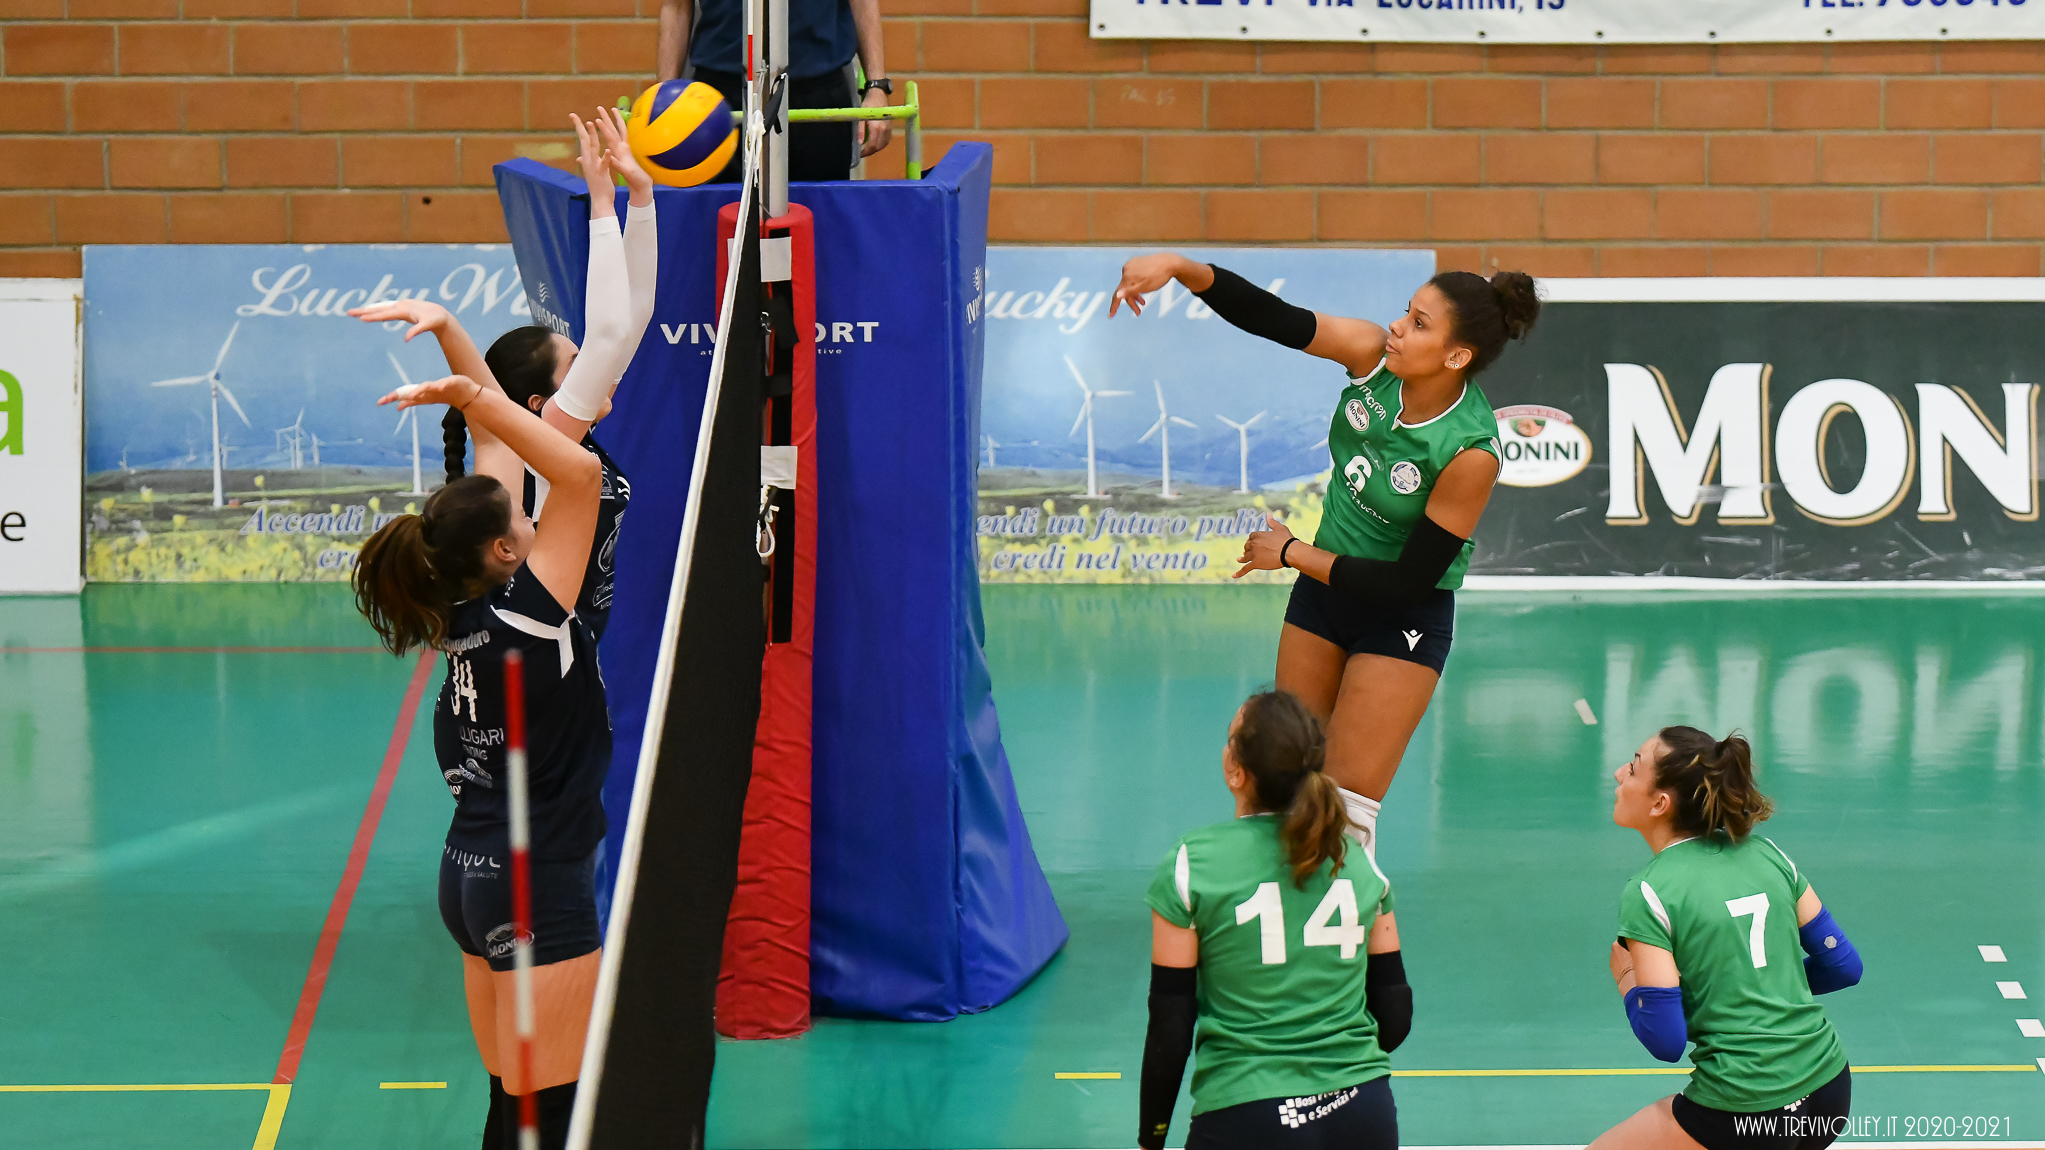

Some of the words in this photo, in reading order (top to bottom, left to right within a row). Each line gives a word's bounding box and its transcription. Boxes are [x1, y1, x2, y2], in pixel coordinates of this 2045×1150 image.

[985, 275, 1107, 335] ucky
[1503, 440, 1579, 462] ONINI
[1343, 455, 1373, 493] 6
[239, 503, 366, 536] Accendi
[976, 507, 1039, 536] endi
[1045, 514, 1086, 536] un
[1087, 507, 1189, 542] futuro
[1194, 508, 1270, 542] pulit
[990, 544, 1067, 571] credi
[1074, 543, 1122, 571] nel
[1130, 550, 1209, 571] vento
[1234, 878, 1365, 964] 14
[1724, 892, 1770, 969] 7
[1308, 1111, 1316, 1121] e
[1315, 1090, 1350, 1119] Servizi
